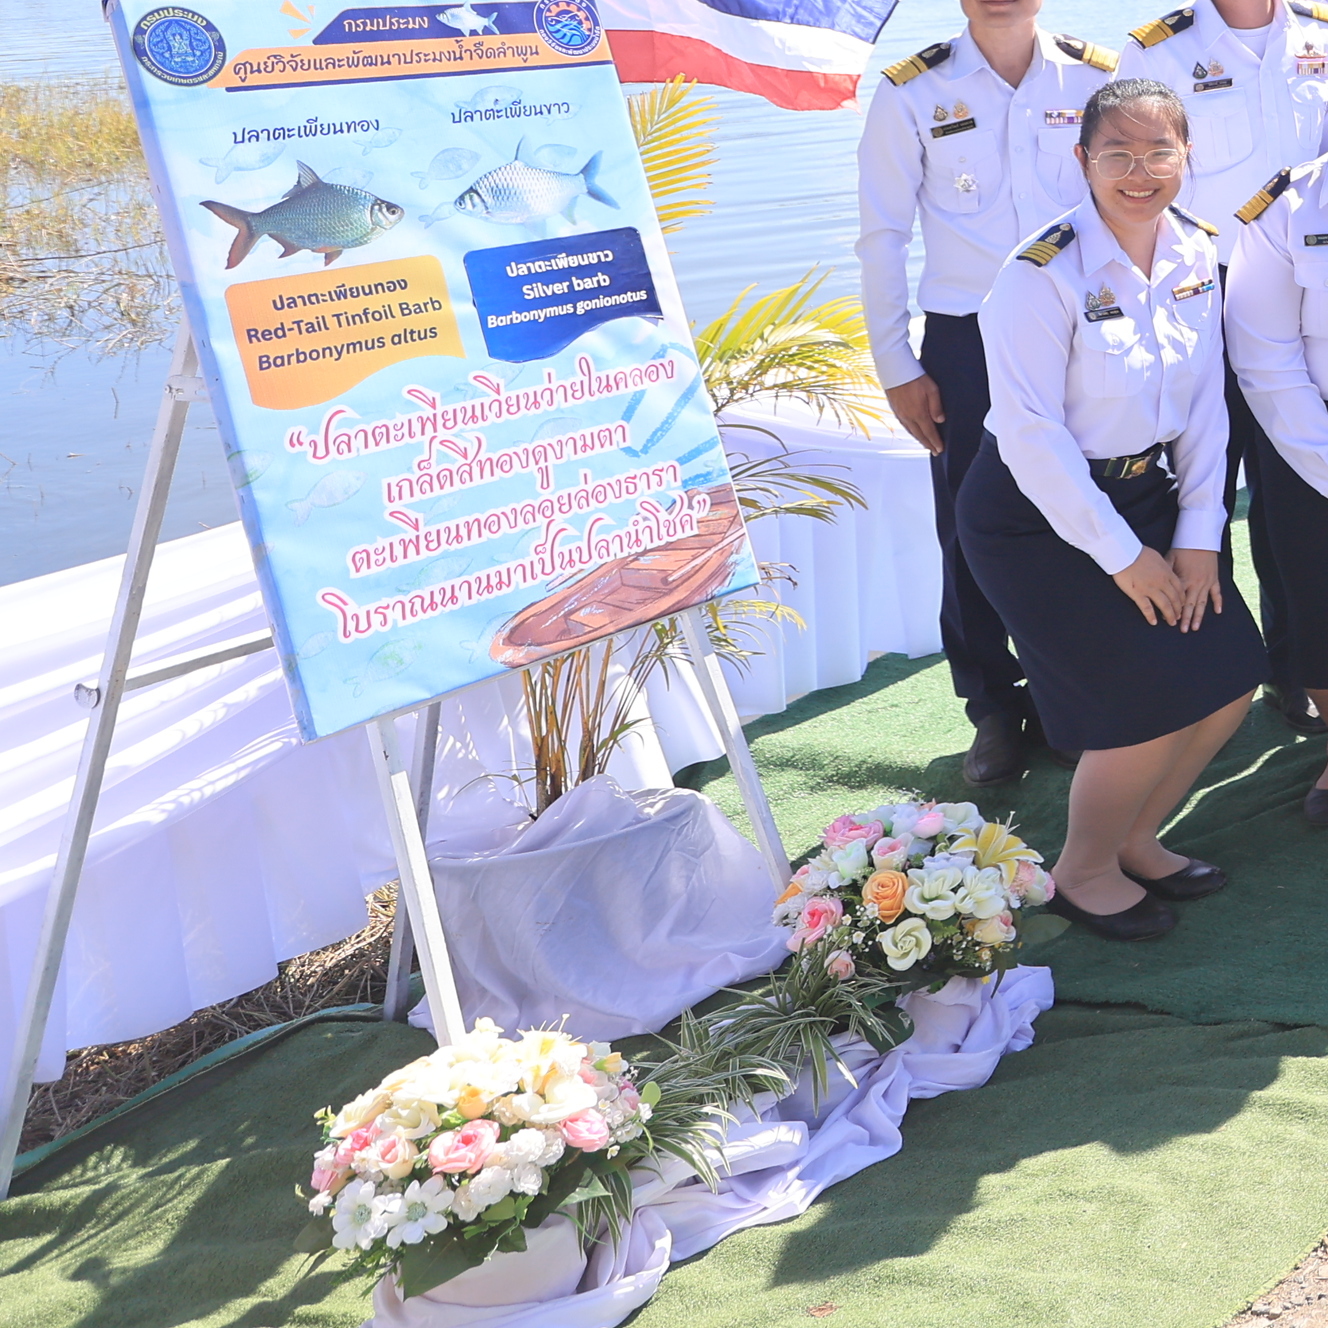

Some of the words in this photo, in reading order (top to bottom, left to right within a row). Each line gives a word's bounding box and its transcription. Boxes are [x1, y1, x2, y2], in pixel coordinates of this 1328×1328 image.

[139, 7, 208, 30] กรมประมง
[342, 16, 429, 33] กรมประมง
[233, 39, 540, 82] ศูนย์วิจัยและพัฒนาประมงน้ำจืดลำพูน
[451, 99, 570, 124] ปลาตะเพียนขาว
[232, 116, 380, 145] ปลาตะเพียนทอง
[505, 249, 614, 278] ปลาตะเพียนขาว
[271, 278, 408, 311] ปลาตะเพียนทอง
[521, 280, 570, 300] Silver
[571, 271, 611, 291] barb
[245, 315, 330, 344] Red-Tail
[331, 303, 396, 328] Tinfoil
[398, 296, 443, 317] Barb
[487, 301, 574, 328] Barbonymus
[575, 289, 648, 315] gonionotus
[257, 335, 386, 371] Barbonymus
[390, 326, 438, 346] altus
[287, 356, 676, 462] “ปลาตะเพียนเวียนว่ายในคลอง
[385, 420, 628, 504] เกล็ดสีทองดูงามตา
[350, 459, 680, 574] ตะเพียนทองลอยล่องธารา
